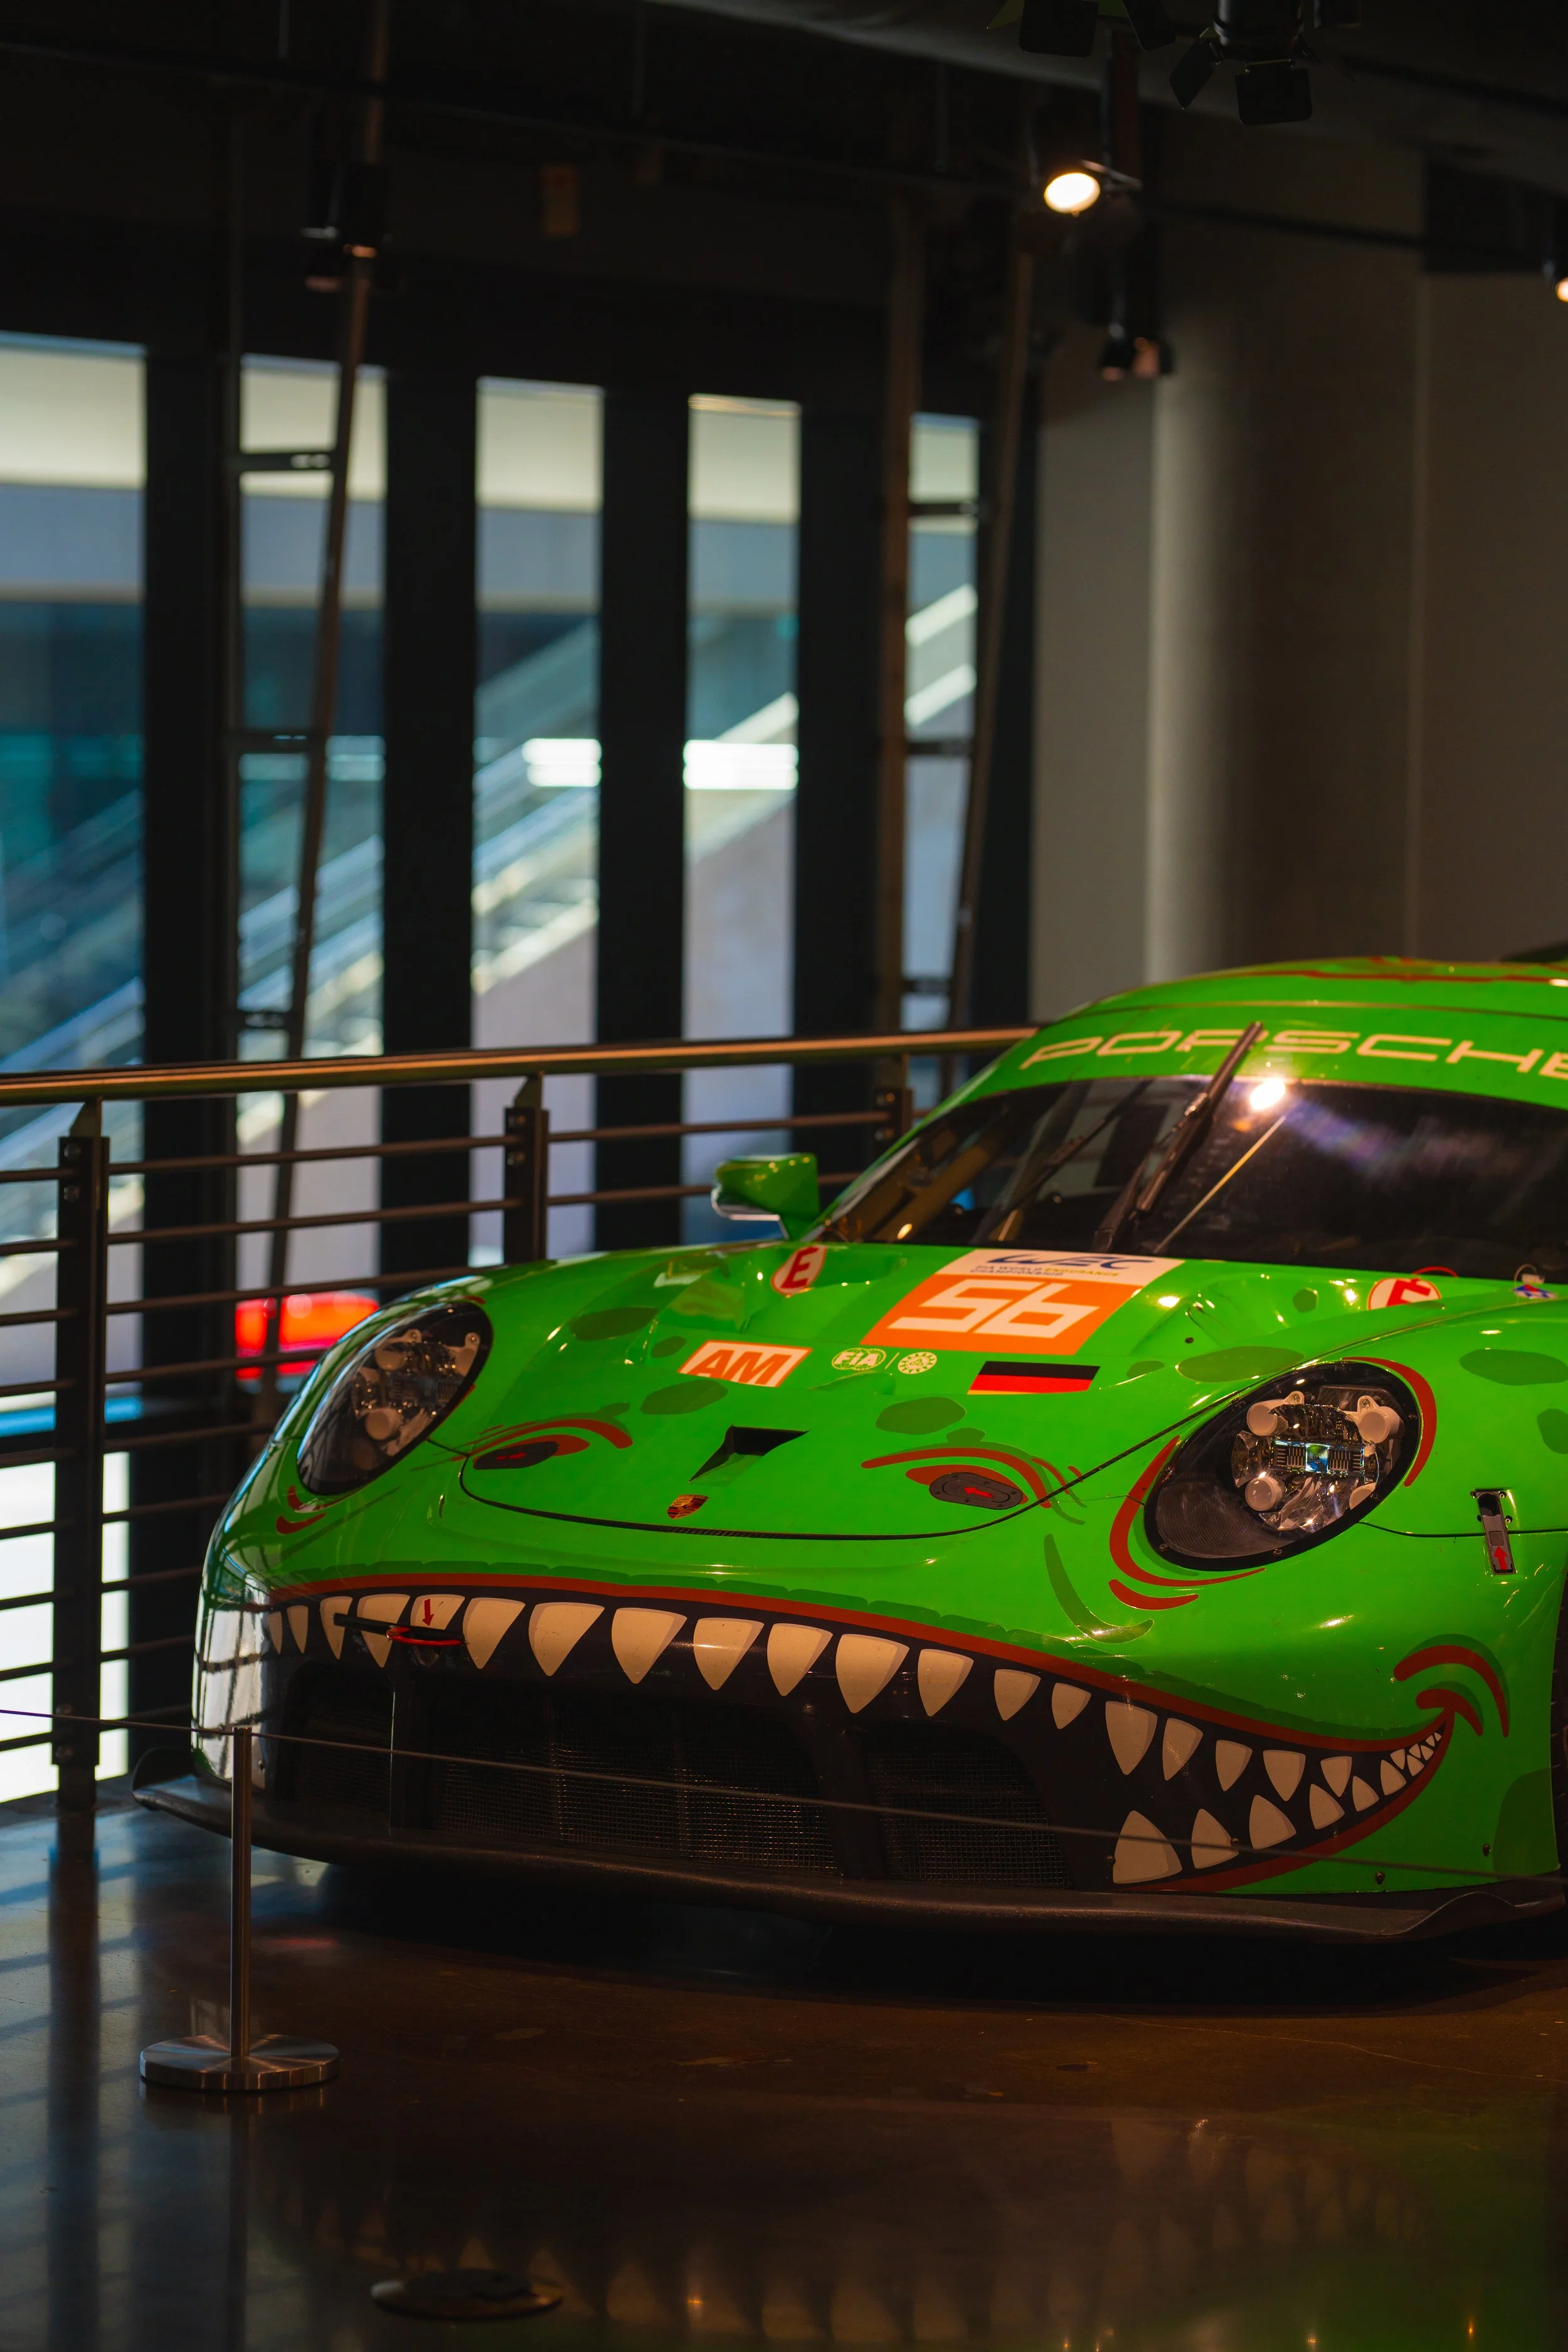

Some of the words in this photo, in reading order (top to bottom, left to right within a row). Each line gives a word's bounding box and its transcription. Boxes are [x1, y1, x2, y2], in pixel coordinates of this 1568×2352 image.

[780, 1246, 819, 1289] E
[970, 1268, 1064, 1276] CHAMPIONSHIP
[987, 1253, 1155, 1269] WEC
[1044, 1267, 1120, 1277] ENDURANCE
[886, 1278, 1101, 1338] 56
[687, 1349, 793, 1385] AM
